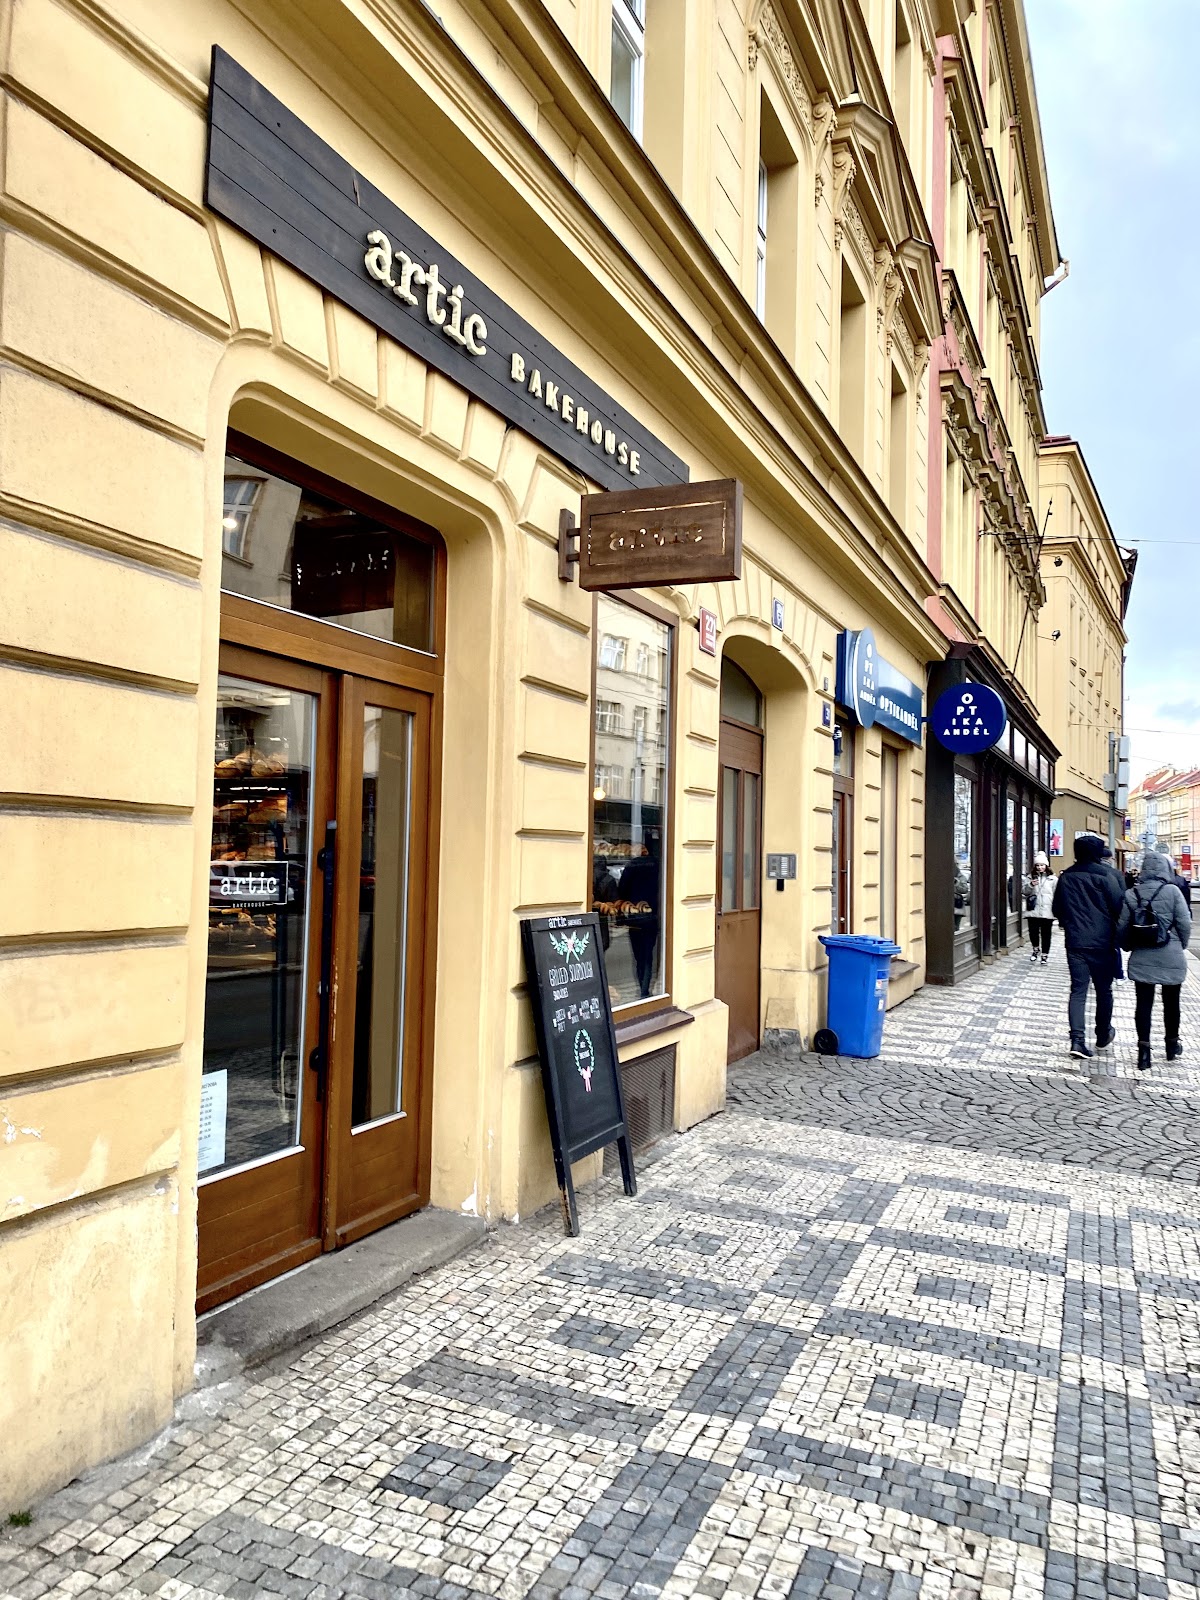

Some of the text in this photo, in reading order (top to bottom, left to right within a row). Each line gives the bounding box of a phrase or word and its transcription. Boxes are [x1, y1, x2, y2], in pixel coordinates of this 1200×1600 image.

[364, 229, 641, 475] artic BAKEHOUSE
[961, 692, 974, 705] O
[943, 726, 990, 736] ANDĚL
[220, 871, 277, 896] artic
[548, 916, 567, 929] artic
